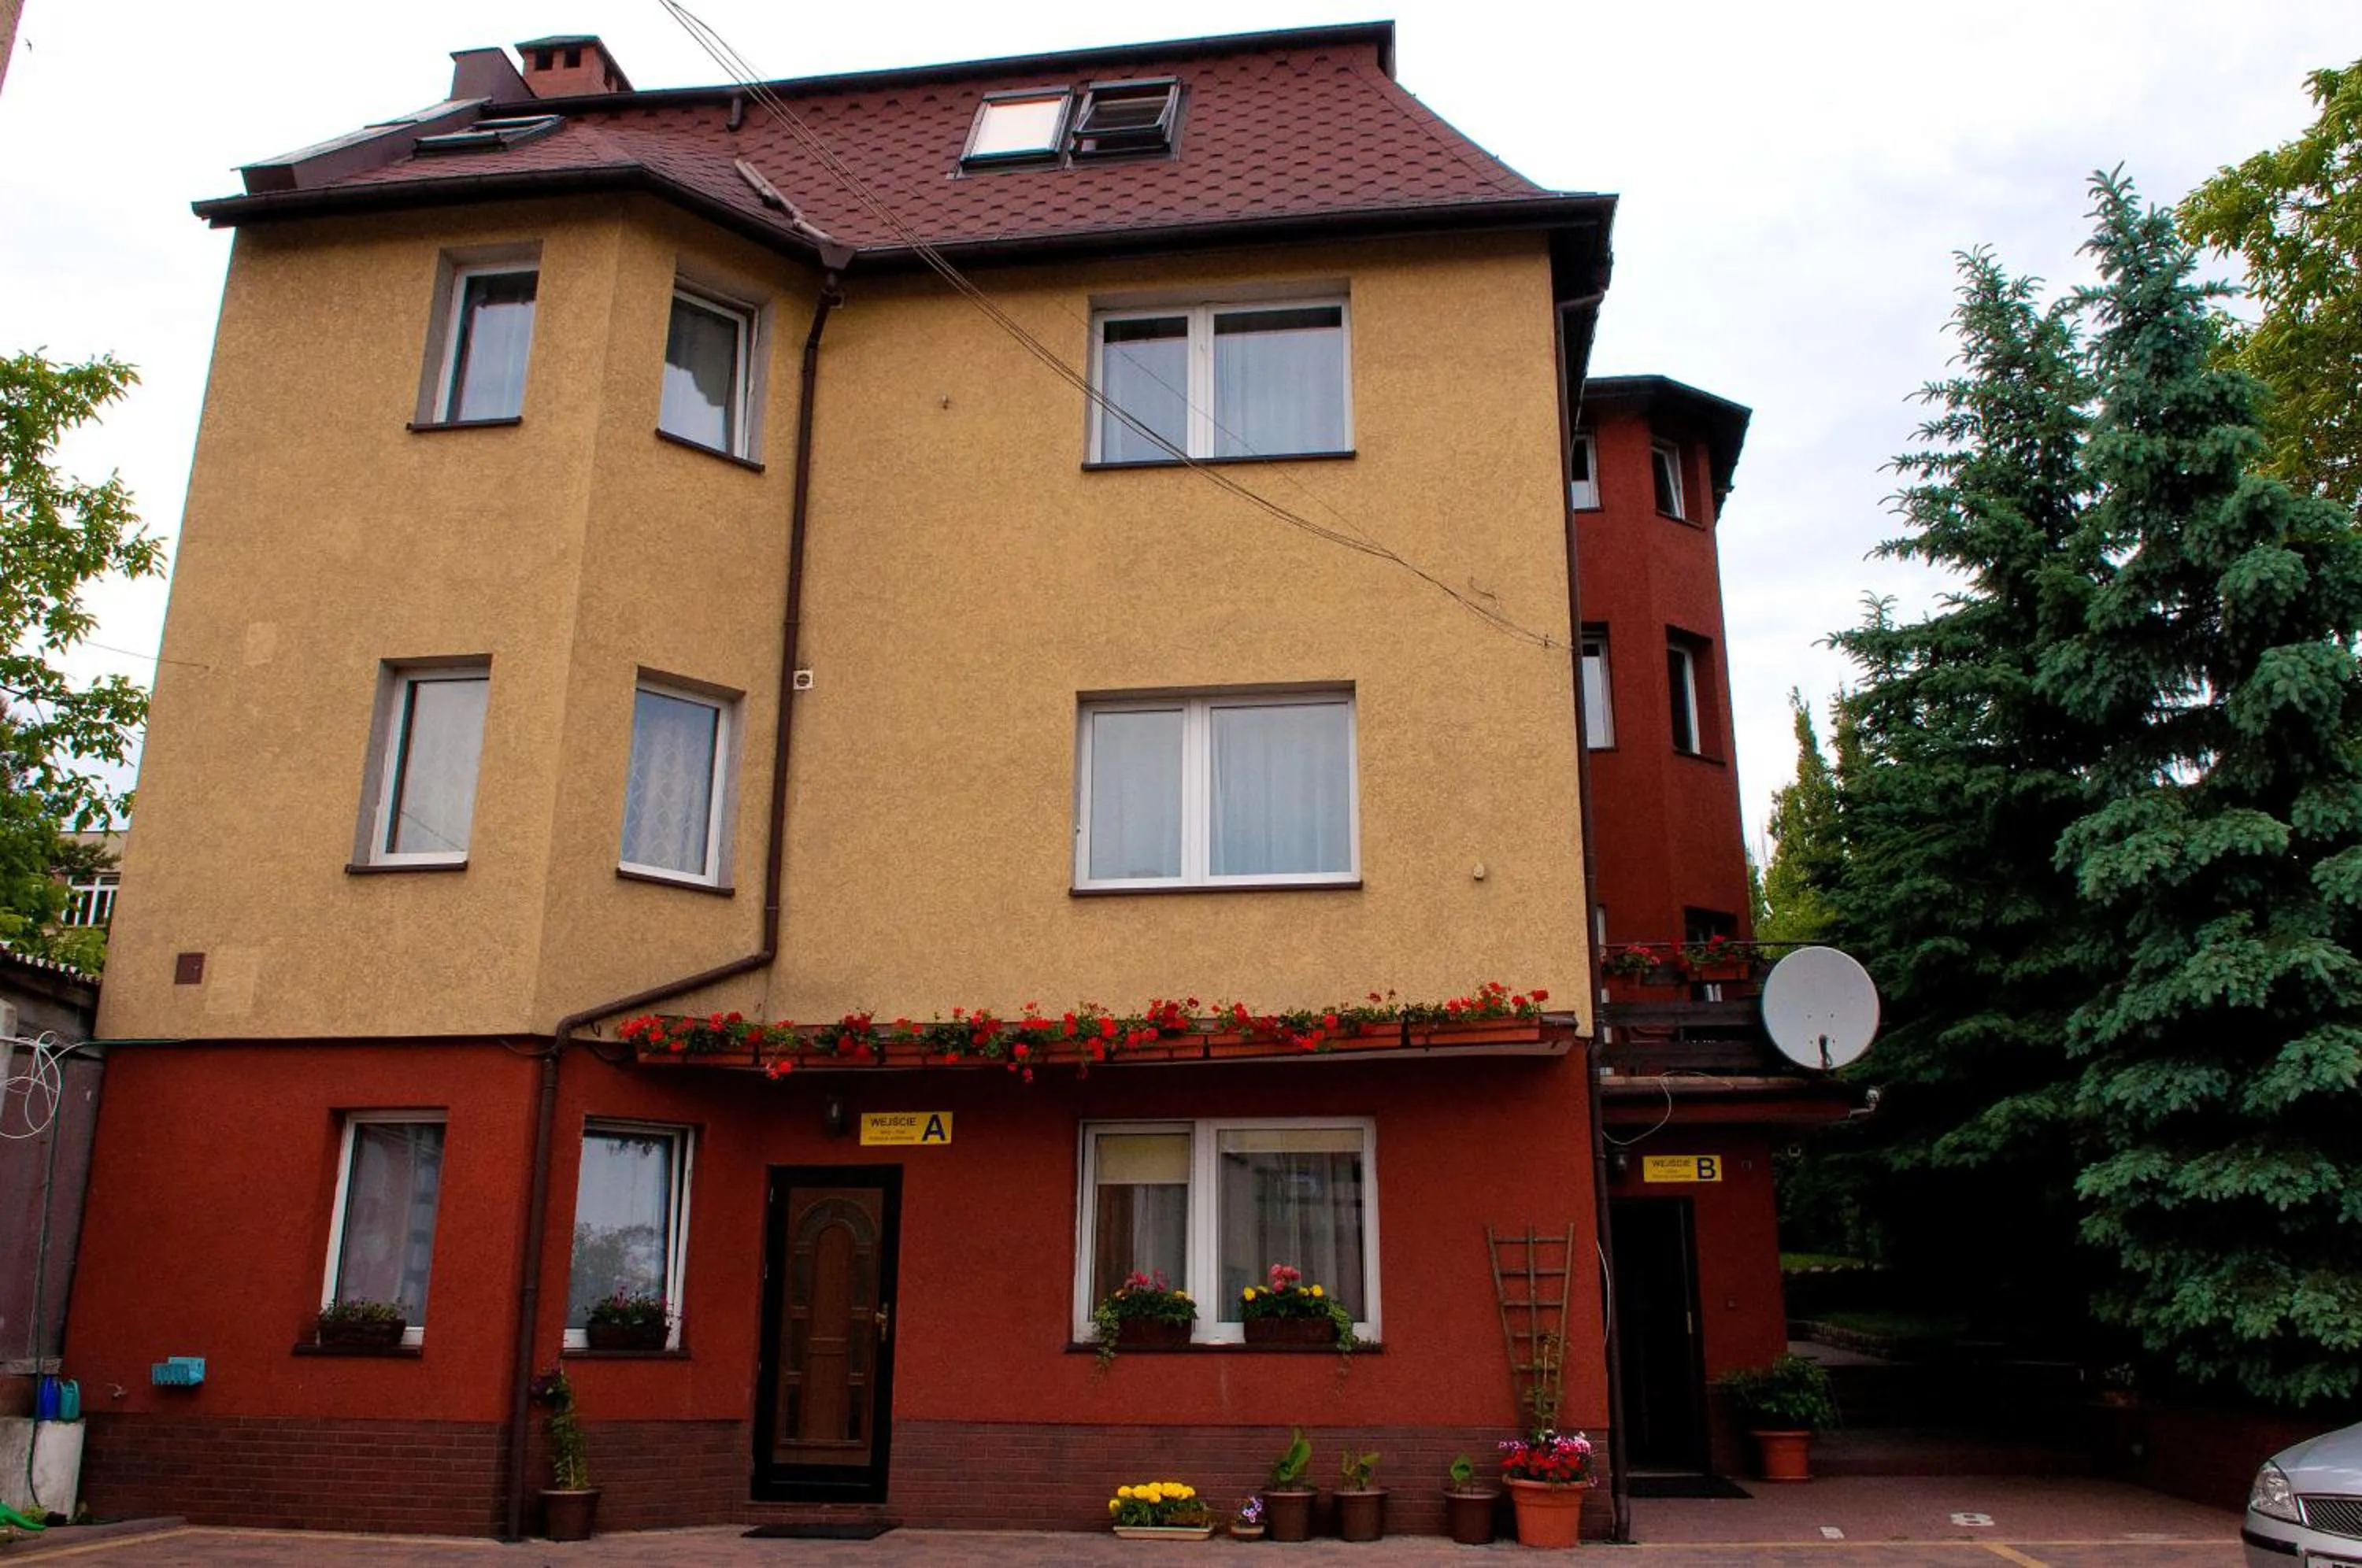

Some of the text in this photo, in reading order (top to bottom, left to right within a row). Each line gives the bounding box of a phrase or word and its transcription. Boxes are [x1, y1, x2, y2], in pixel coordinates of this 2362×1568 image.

[871, 1113, 946, 1142] WEJŚCIE A
[1697, 1156, 1716, 1180] B
